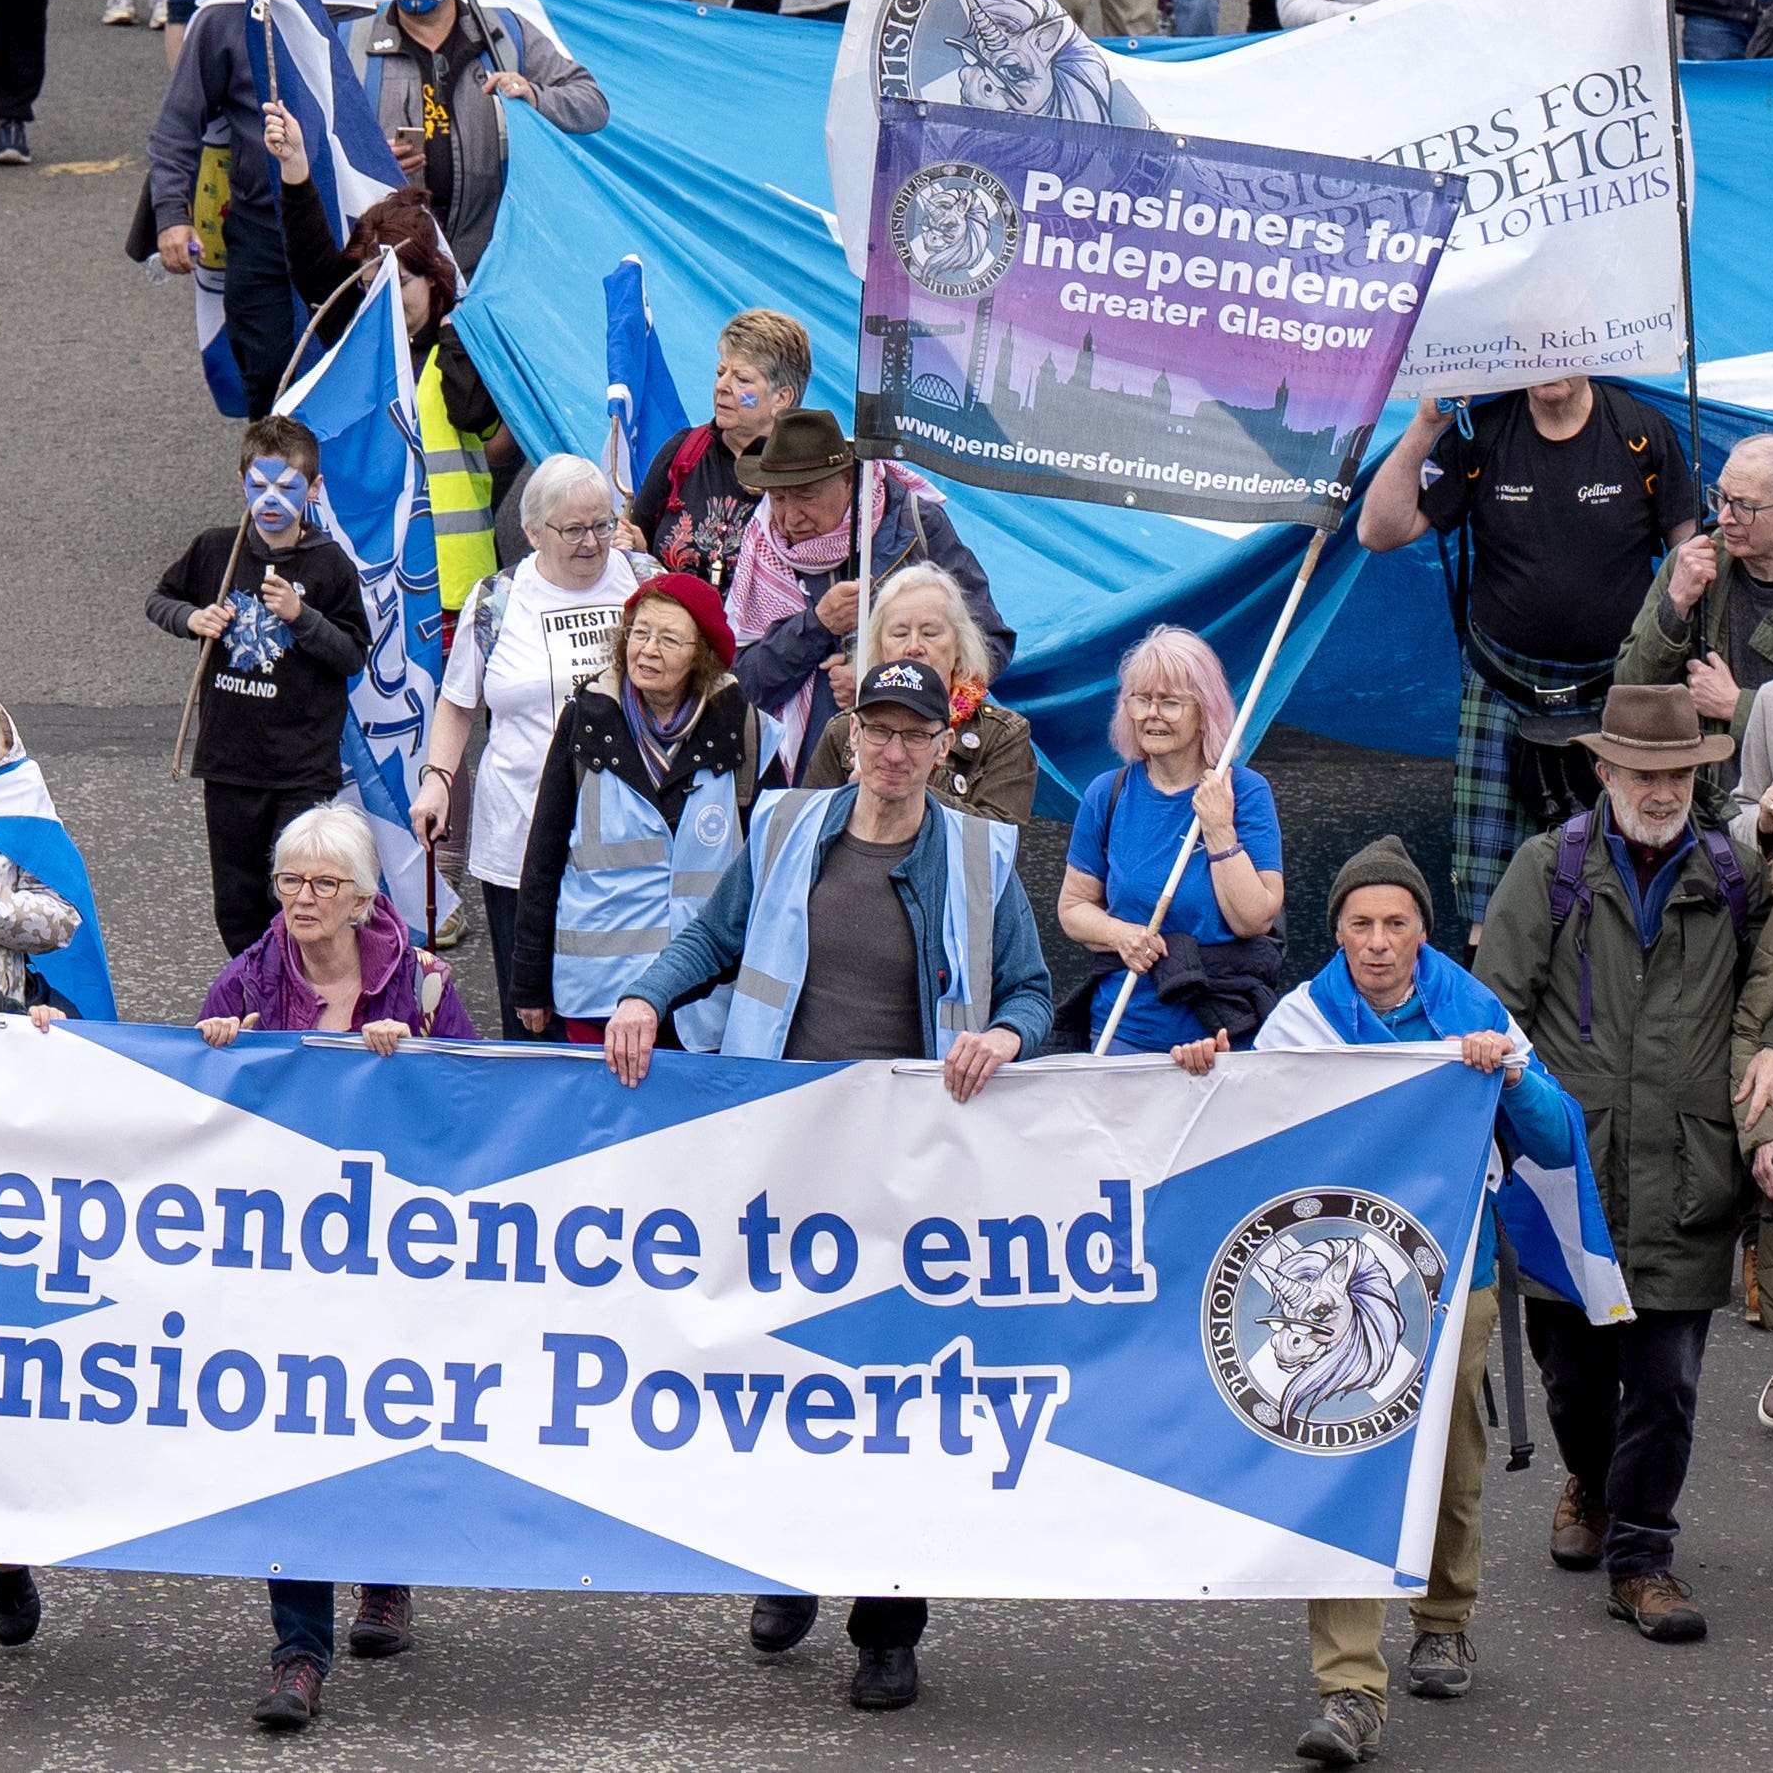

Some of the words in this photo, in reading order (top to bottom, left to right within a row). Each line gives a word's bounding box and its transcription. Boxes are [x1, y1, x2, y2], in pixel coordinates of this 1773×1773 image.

[1536, 64, 1653, 133] FOR
[969, 168, 1001, 195] FOR
[1477, 166, 1671, 246] LOTHIANS
[1022, 169, 1346, 255] Pensioners
[1364, 219, 1445, 266] for
[1022, 222, 1420, 314] Independence
[1060, 282, 1208, 329] Greater
[1218, 303, 1374, 352] Glasgow
[1540, 326, 1597, 350] Rich
[1578, 482, 1623, 503] Gellions
[545, 617, 552, 633] I
[554, 611, 606, 632] DETEST
[214, 672, 278, 700] SCOTLAND
[571, 658, 579, 667] &
[581, 657, 598, 666] ALL
[873, 679, 923, 691] SCOTLAND
[738, 1189, 859, 1294] to
[902, 1179, 1146, 1297] end
[1347, 1196, 1407, 1245] FOR
[1210, 1216, 1275, 1401] PENSIONERS
[538, 1332, 1058, 1490] Poverty
